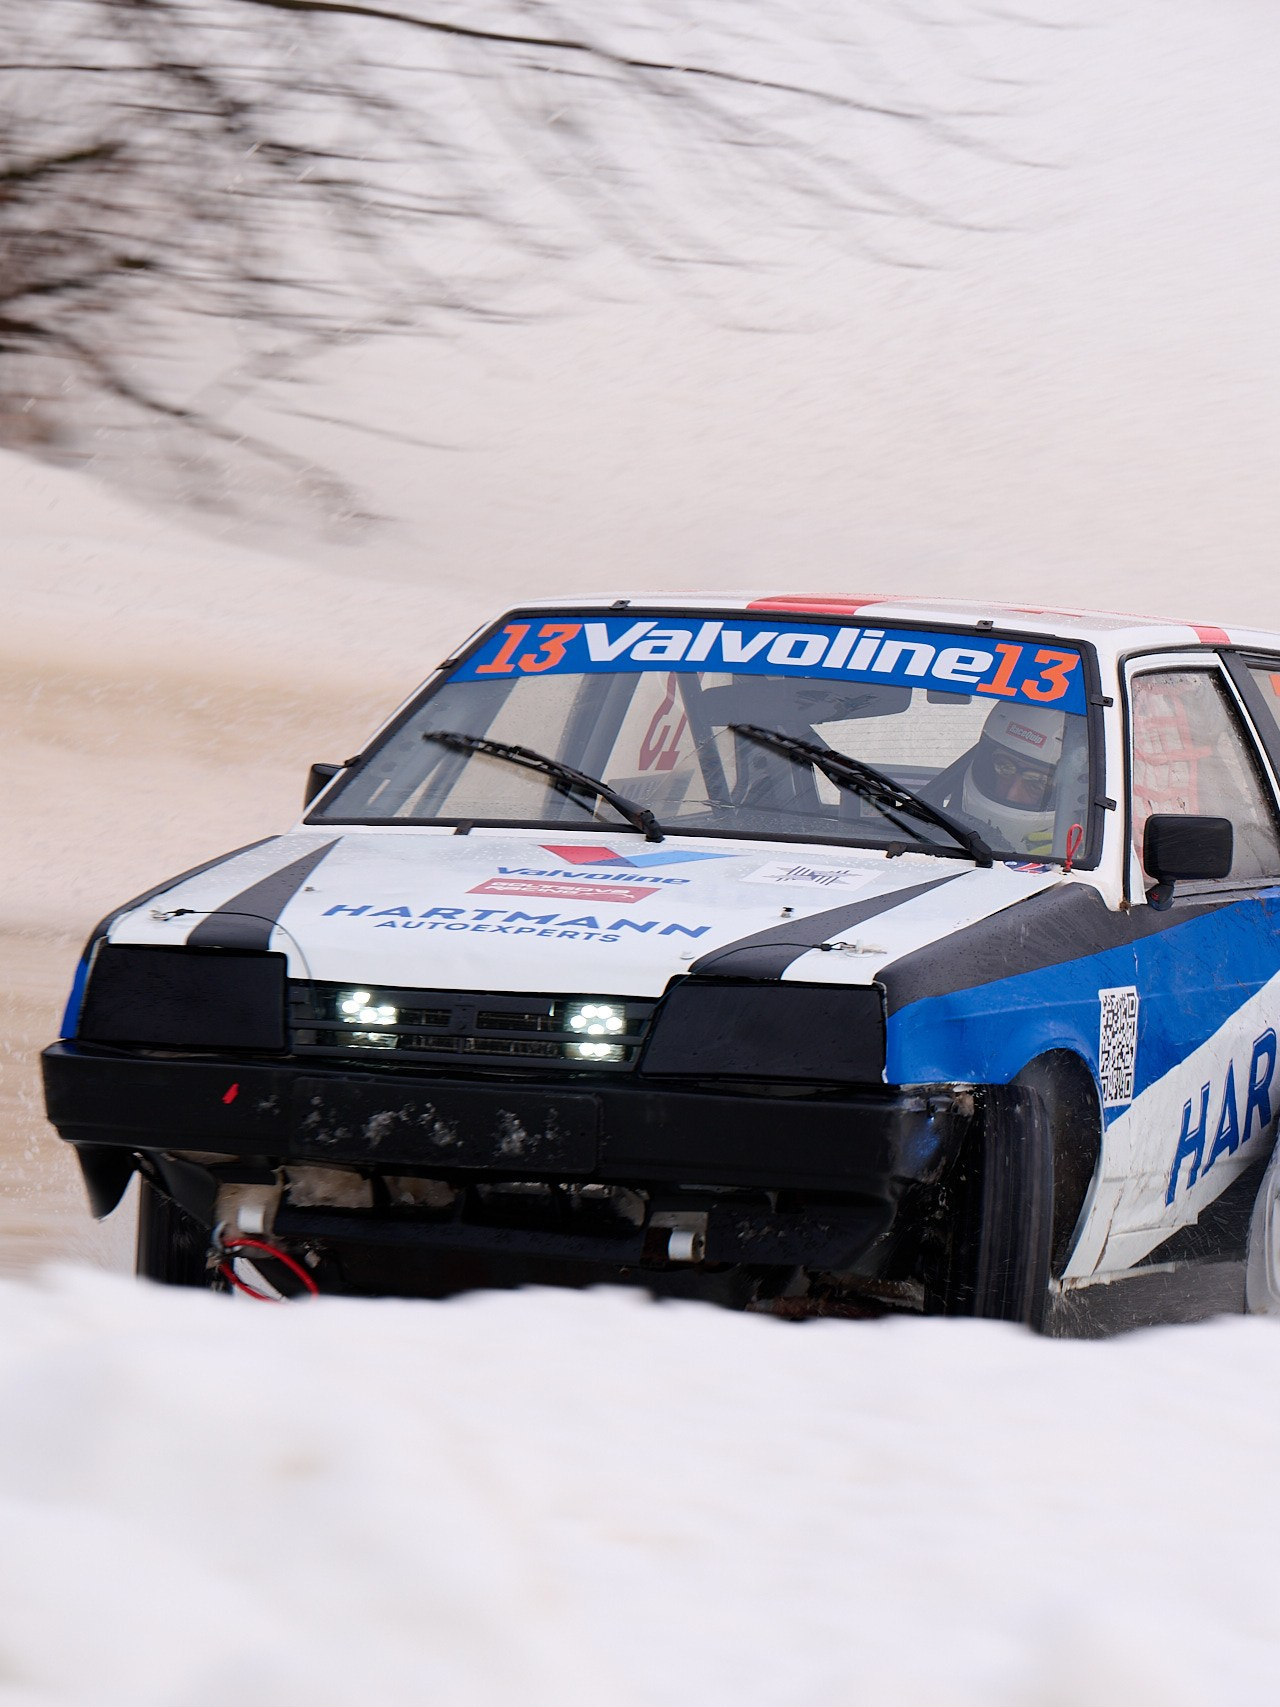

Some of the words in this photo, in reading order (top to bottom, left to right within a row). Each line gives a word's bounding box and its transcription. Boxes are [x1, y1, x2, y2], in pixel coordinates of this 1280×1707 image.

[475, 624, 583, 673] 13
[584, 621, 994, 683] Valvoline
[976, 643, 1080, 702] 13
[497, 866, 691, 885] Valvoline
[321, 904, 712, 939] HARTMANN
[373, 920, 621, 943] AUTOEXPERTS
